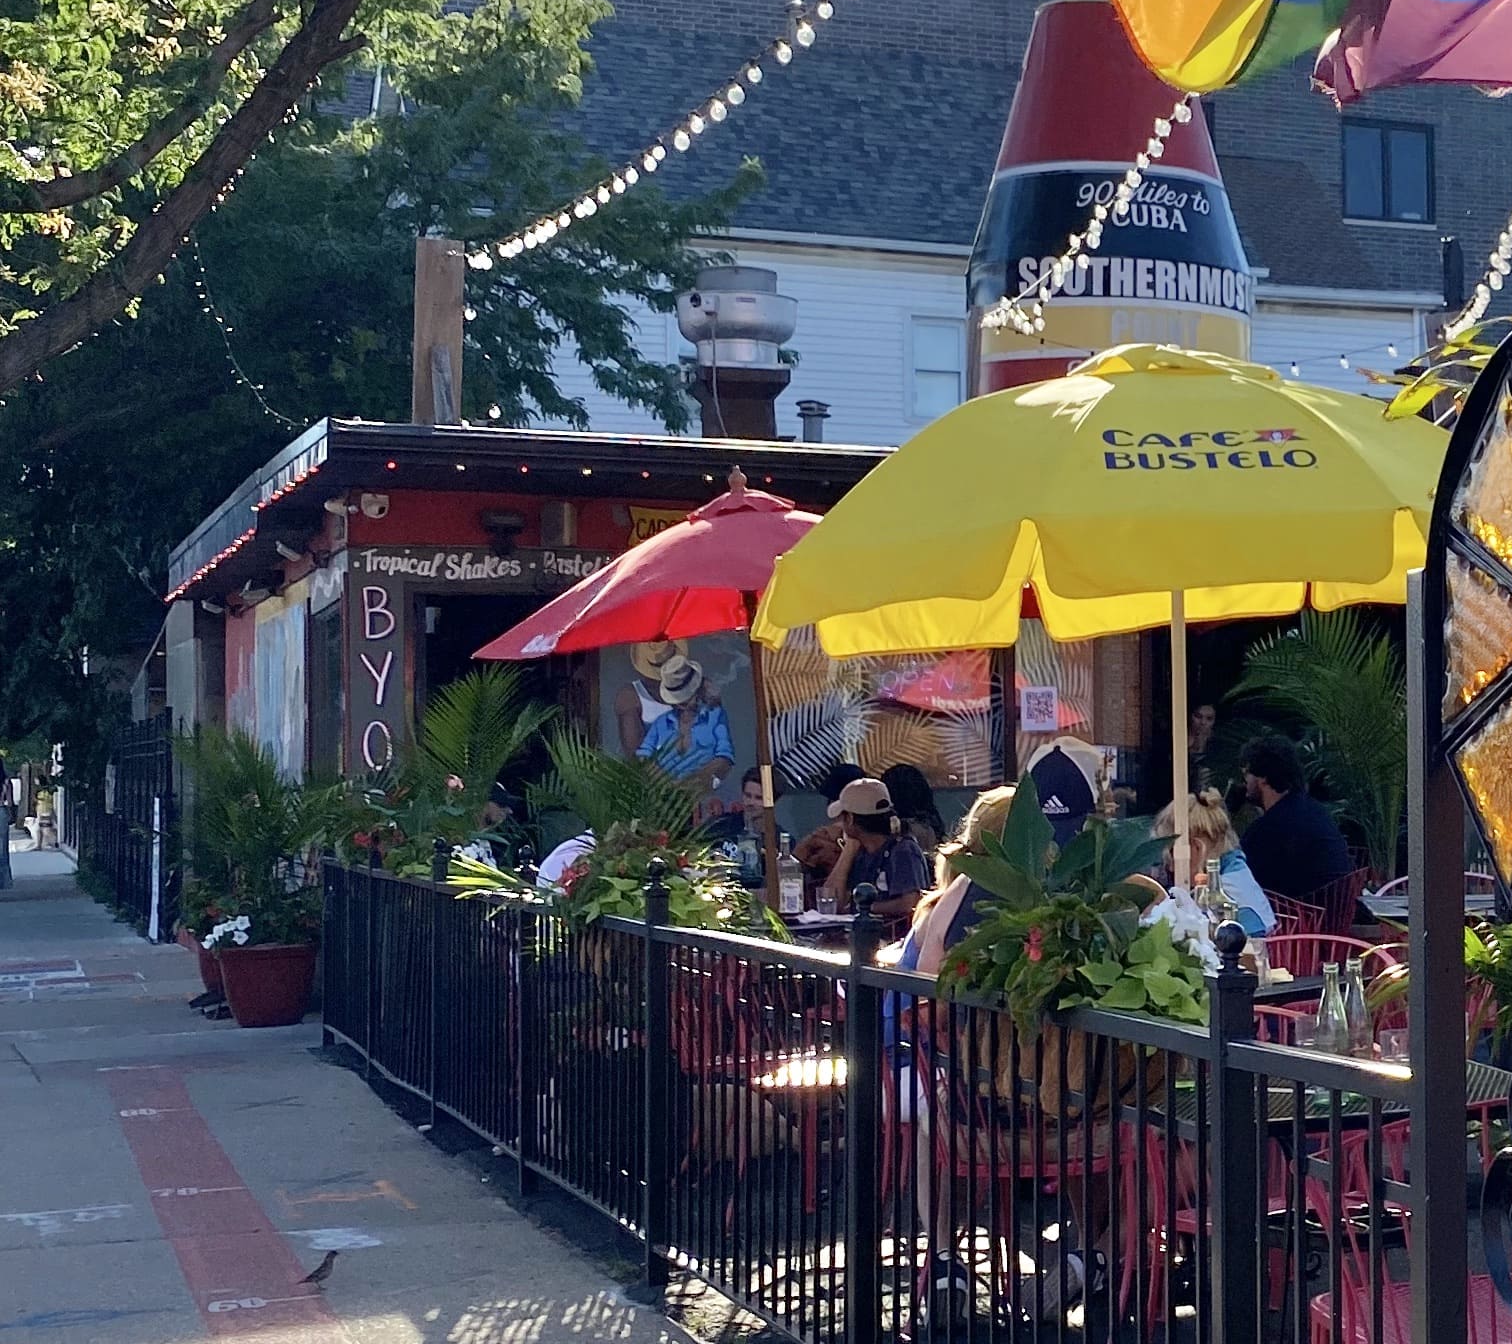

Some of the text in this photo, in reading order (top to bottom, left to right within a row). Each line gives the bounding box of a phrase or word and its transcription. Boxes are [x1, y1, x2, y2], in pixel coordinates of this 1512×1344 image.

[1076, 180, 1114, 208] 90
[1191, 191, 1210, 215] to
[1111, 203, 1188, 233] CUBA
[1104, 449, 1318, 470] BUSTELO
[360, 548, 445, 577] Tropical
[444, 550, 522, 581] Shakes
[880, 669, 956, 694] OPEN
[207, 1297, 267, 1313] 60
